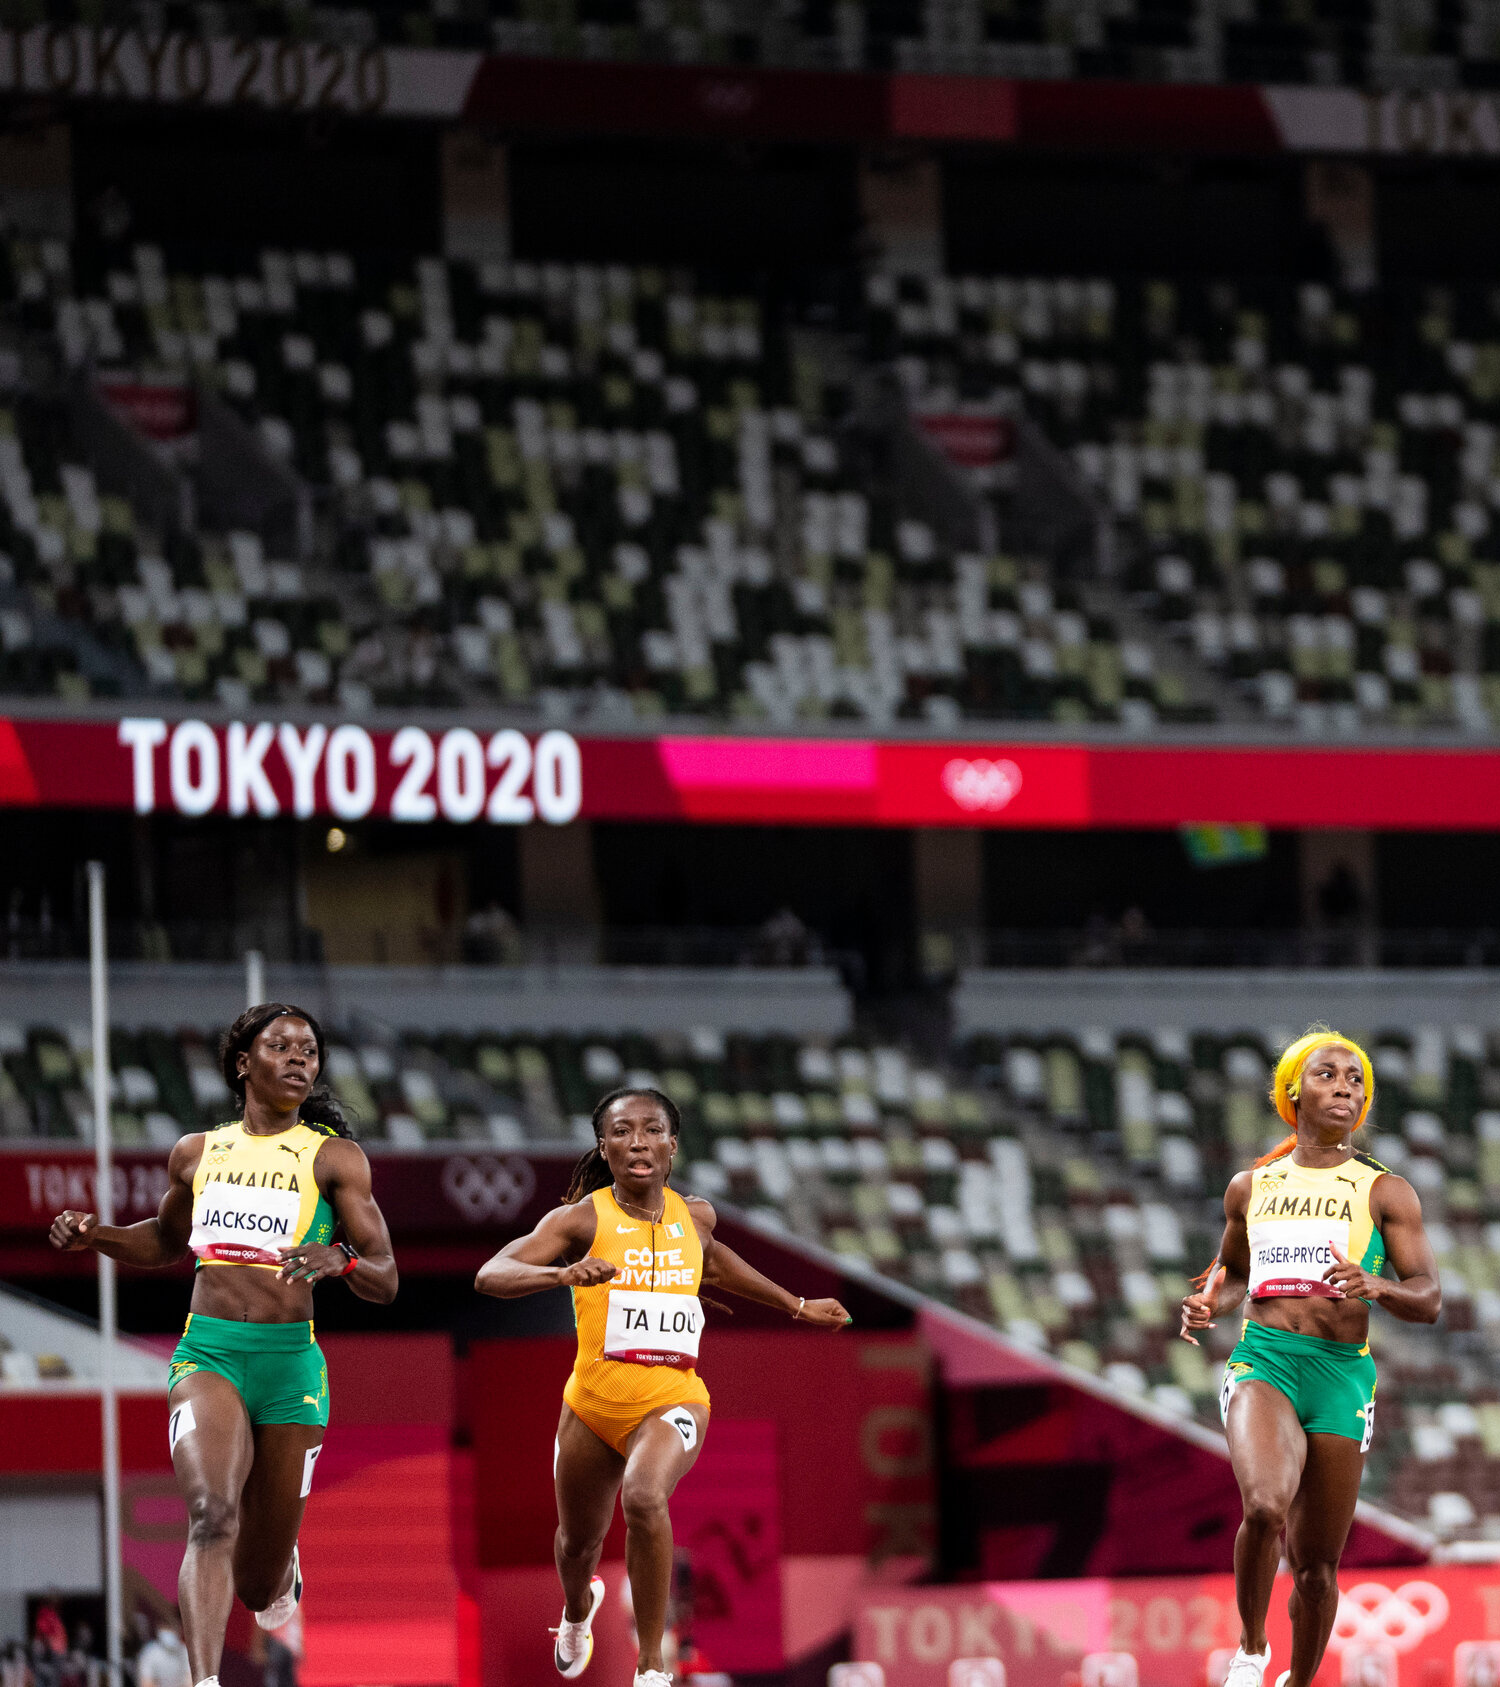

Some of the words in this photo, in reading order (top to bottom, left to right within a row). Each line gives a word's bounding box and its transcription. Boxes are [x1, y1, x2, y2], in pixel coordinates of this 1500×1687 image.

[3, 28, 209, 100] TOKYO
[232, 36, 388, 114] 2020
[118, 717, 378, 821] TOKYO
[388, 725, 584, 825] 2020
[202, 1209, 288, 1235] JACKSON
[1255, 1197, 1352, 1222] JAMAICA
[624, 1246, 684, 1267] CÔTE
[1258, 1246, 1331, 1266] FRASER-PRYCE
[623, 1308, 649, 1331] TA
[659, 1311, 696, 1334] LOU
[636, 1353, 652, 1361] TOKYO
